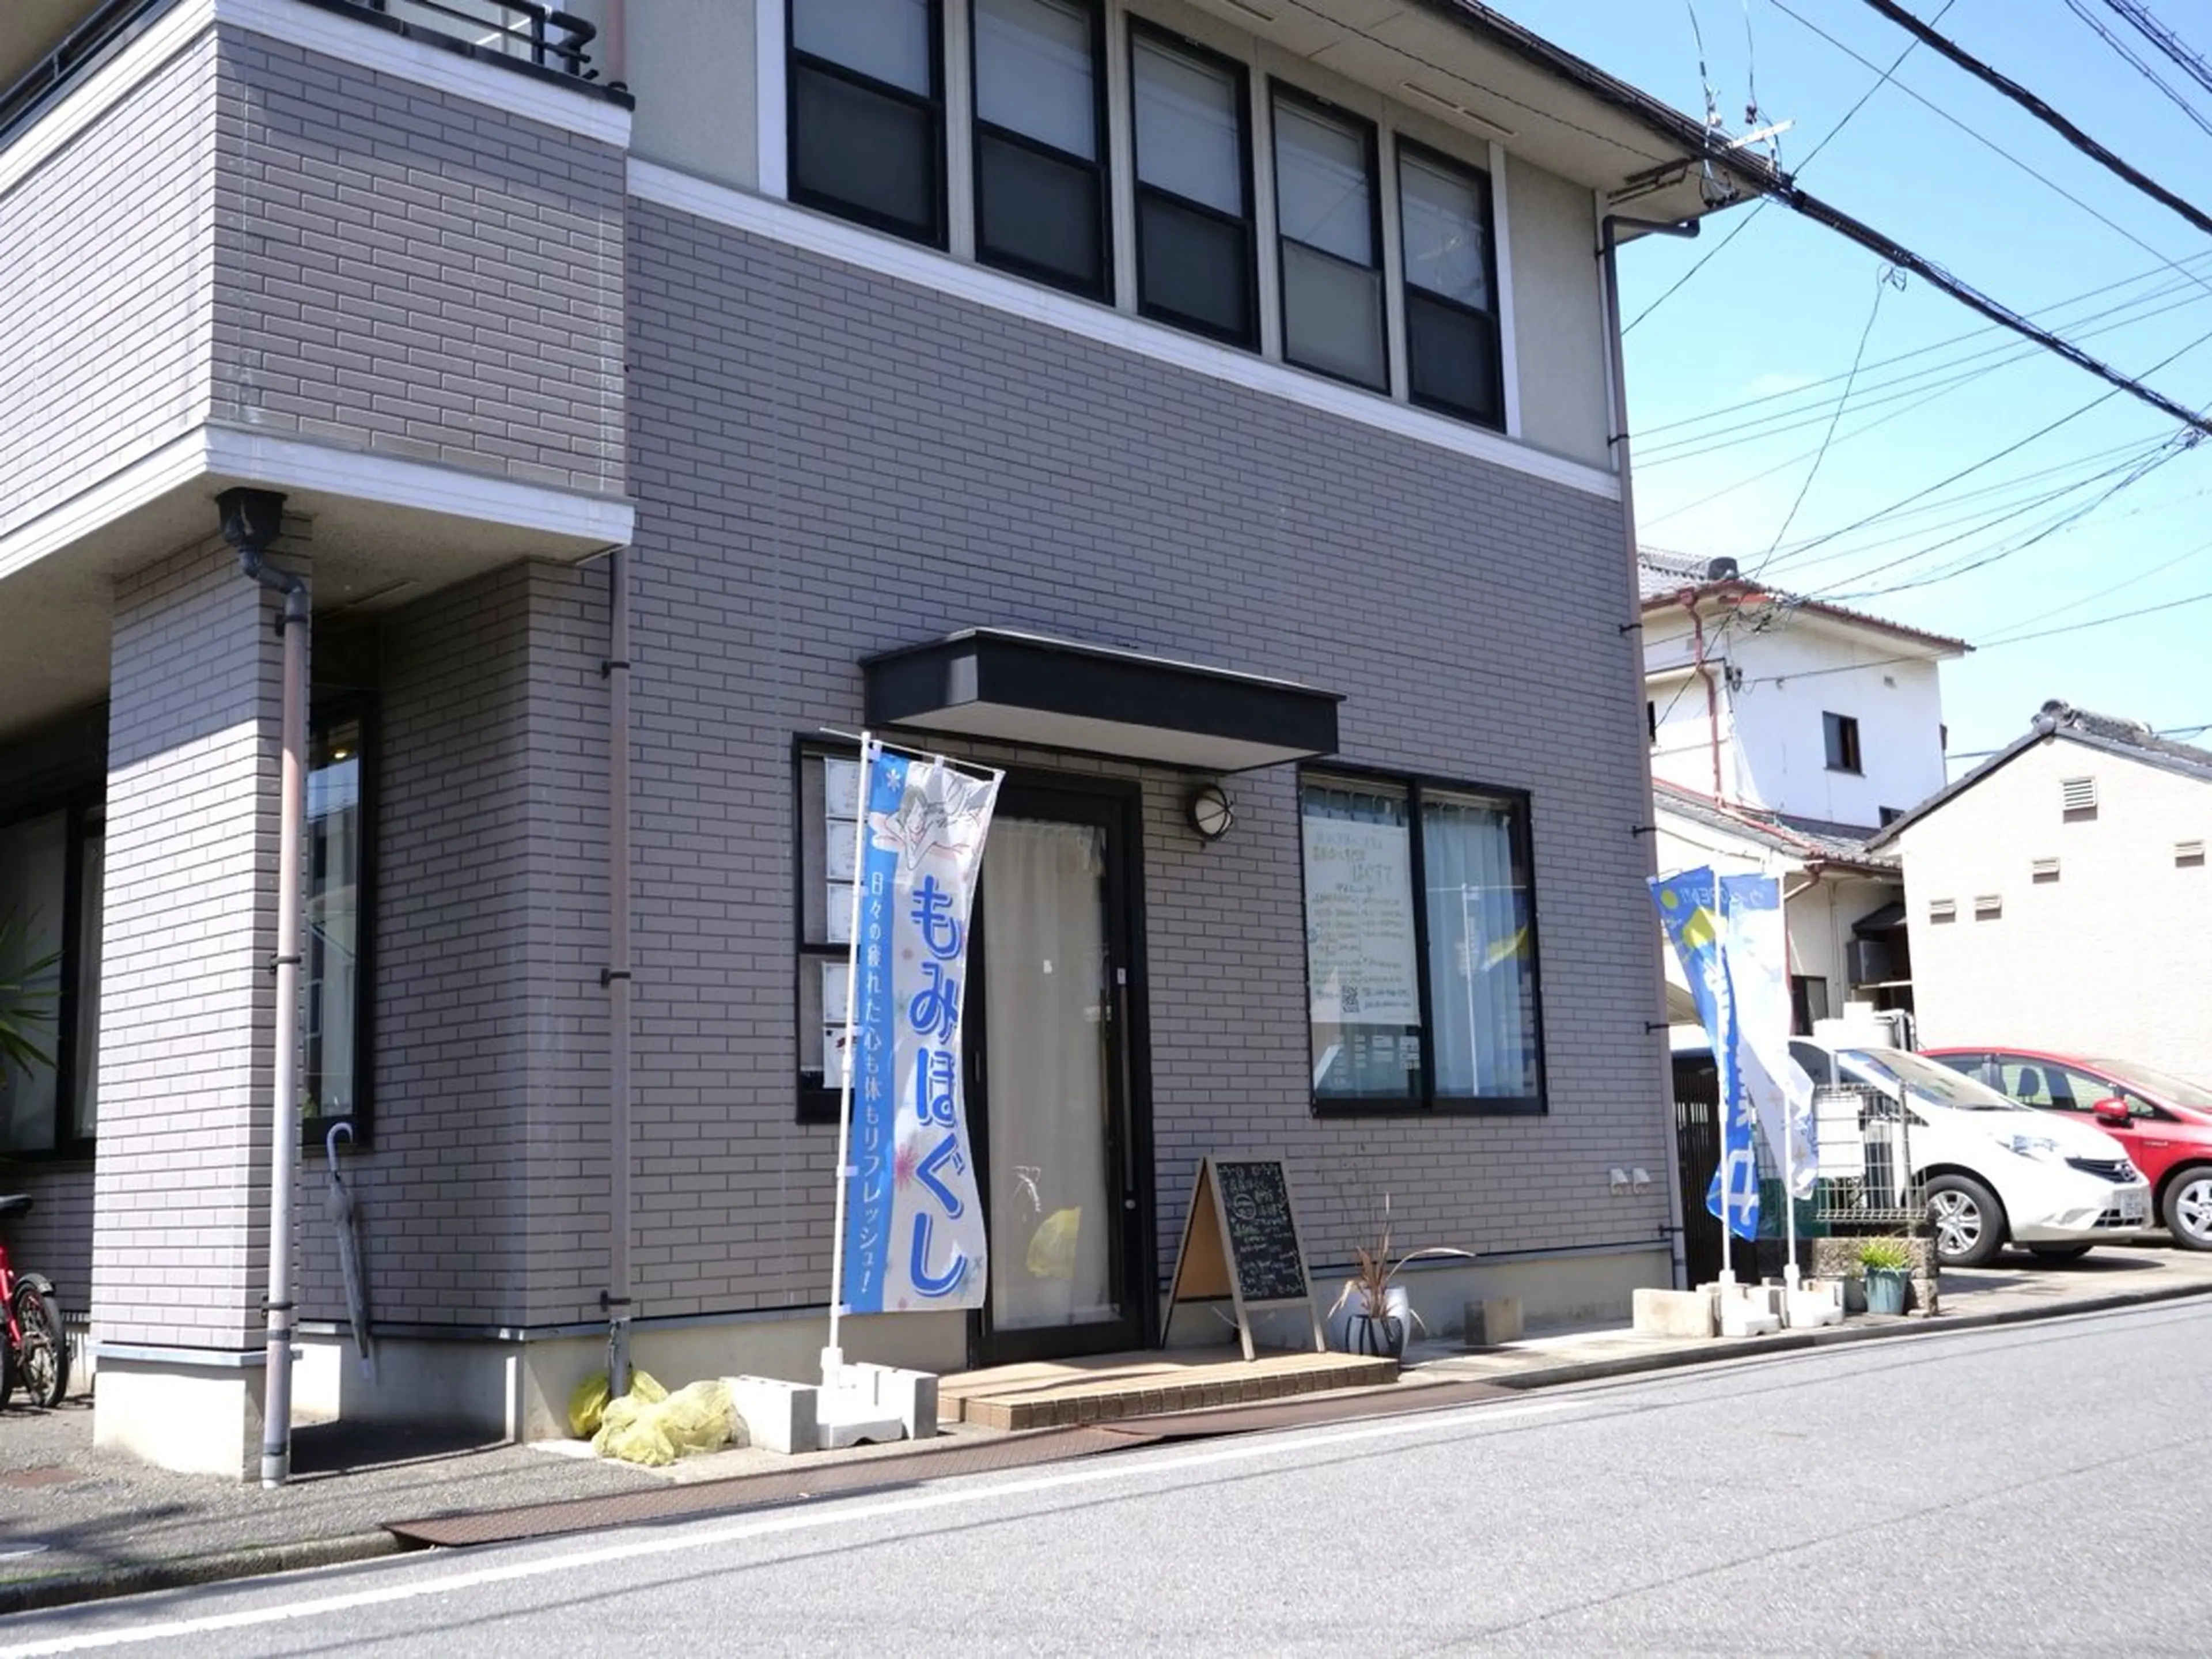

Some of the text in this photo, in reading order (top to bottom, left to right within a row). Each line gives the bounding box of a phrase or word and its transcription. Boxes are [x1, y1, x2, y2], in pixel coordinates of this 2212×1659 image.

[908, 874, 969, 1297] もみほぐし
